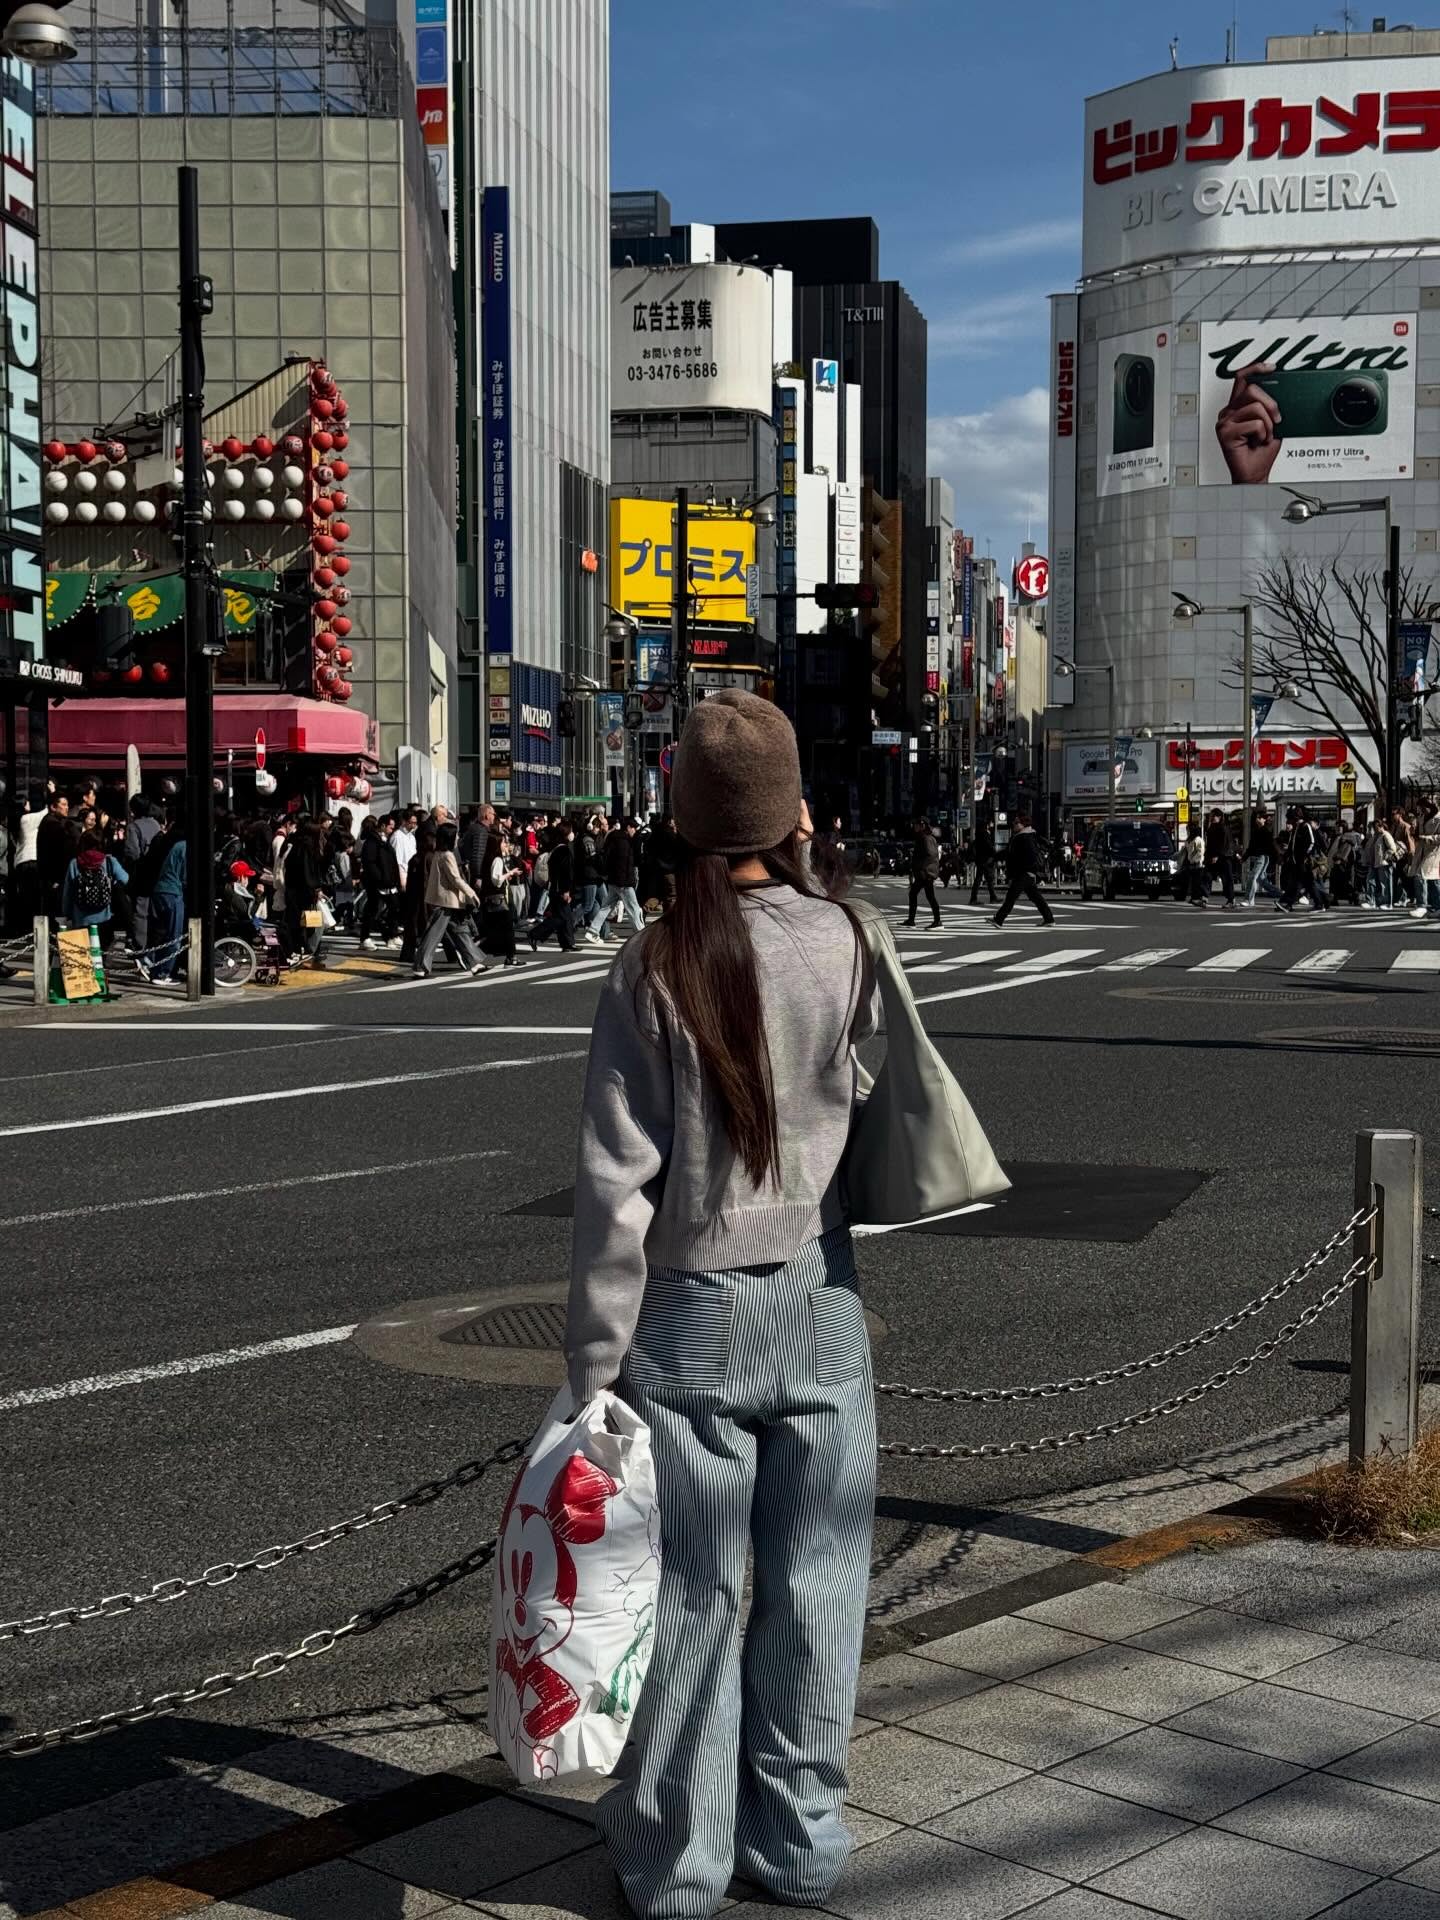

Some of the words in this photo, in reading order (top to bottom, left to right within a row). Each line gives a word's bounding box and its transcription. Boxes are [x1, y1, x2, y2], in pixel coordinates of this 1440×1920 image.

[421, 110, 443, 126] JTB
[1093, 89, 1440, 184] ビックカメラ
[1123, 187, 1182, 231] BIC
[1192, 169, 1398, 216] CAMERA
[493, 232, 504, 283] MIZUHO
[632, 299, 713, 333] 広告主募集
[627, 362, 718, 381] 03-3476-5686
[642, 346, 703, 359] お問い合わせ
[1208, 334, 1410, 380] Ultra
[3, 97, 43, 660] ELEPHANT
[491, 360, 504, 420] みずほ証券
[1332, 448, 1341, 457] 17
[1343, 447, 1364, 456] Ultra
[492, 438, 505, 521] みずほ信託銀行
[493, 538, 506, 598] みずほ銀行
[620, 537, 747, 583] プロミス
[31, 663, 53, 681] CROSS
[521, 704, 552, 729] MIZUHO
[1167, 737, 1349, 769] ビックカメラ
[1192, 776, 1224, 793] BIC
[1229, 774, 1325, 793] CAMERA
